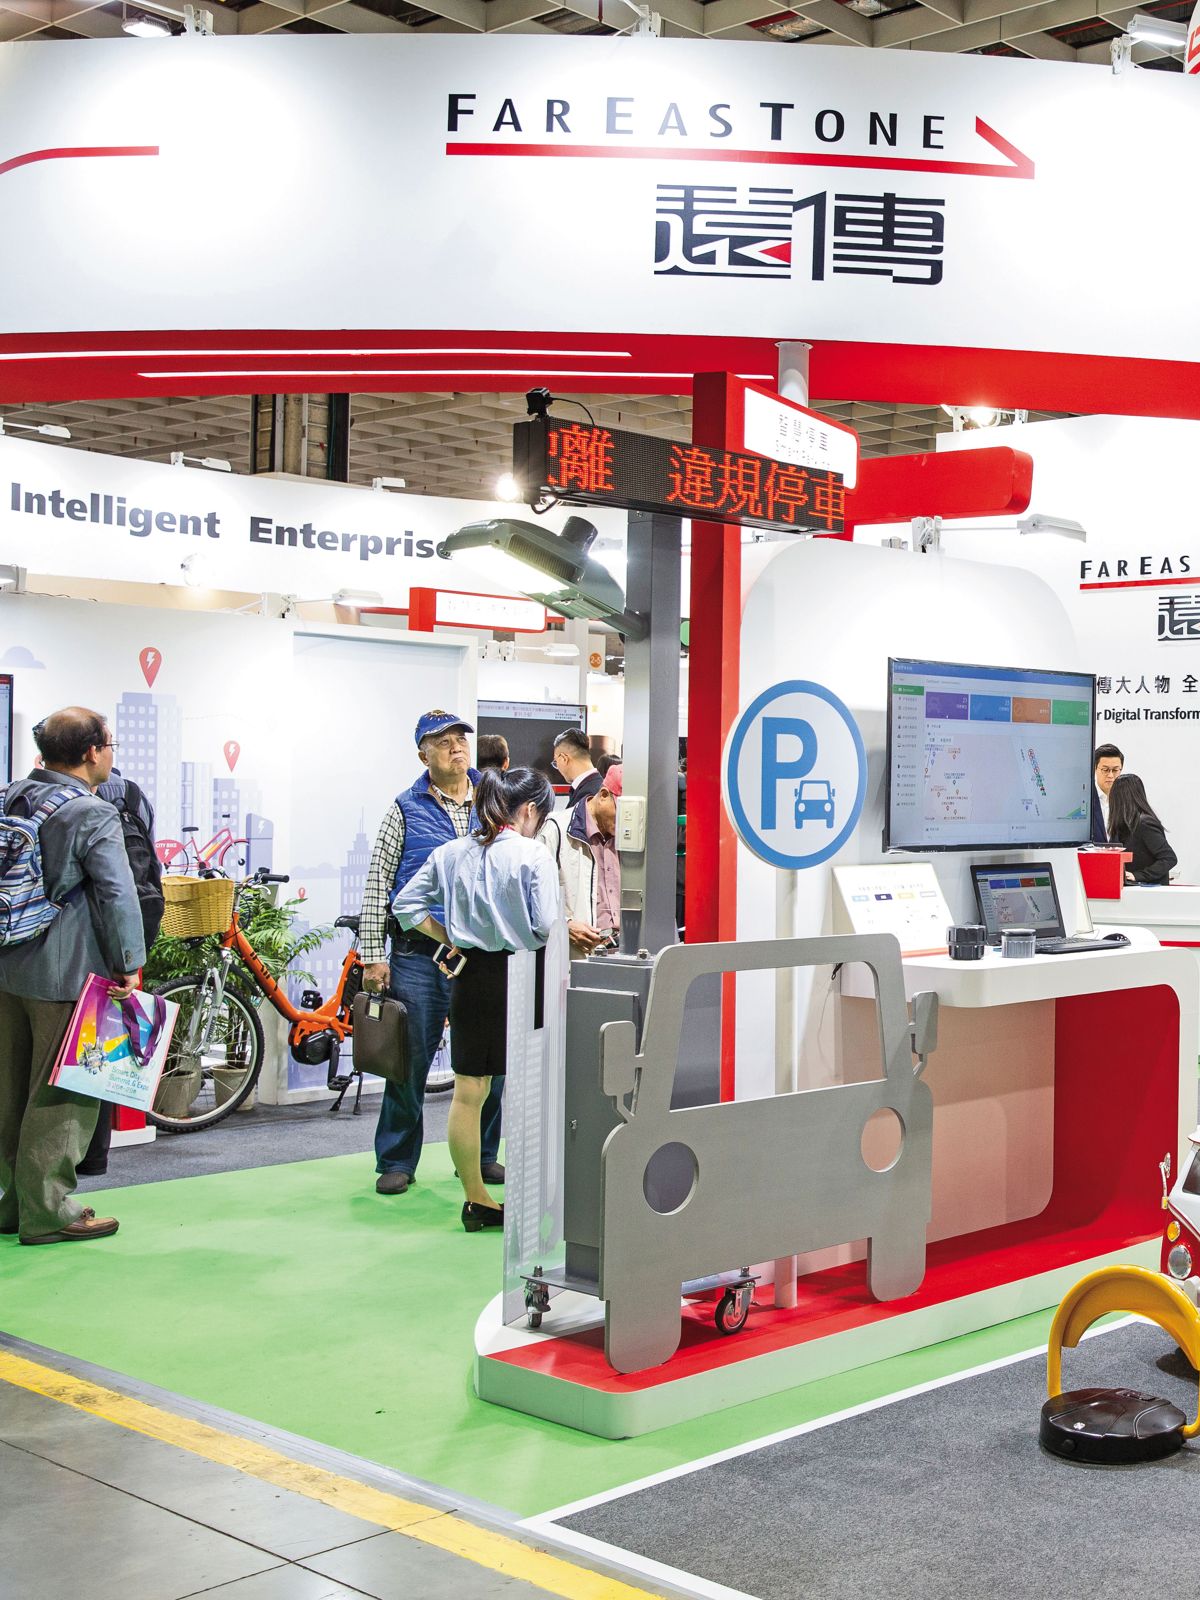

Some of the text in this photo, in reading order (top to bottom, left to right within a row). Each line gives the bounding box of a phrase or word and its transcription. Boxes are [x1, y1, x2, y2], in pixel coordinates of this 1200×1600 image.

[447, 94, 945, 149] FAREASTONE
[654, 184, 945, 285] 遠傳
[11, 483, 220, 538] Intelligent
[667, 445, 845, 529] 違規停車
[1104, 708, 1140, 724] Digital
[761, 717, 818, 830] P
